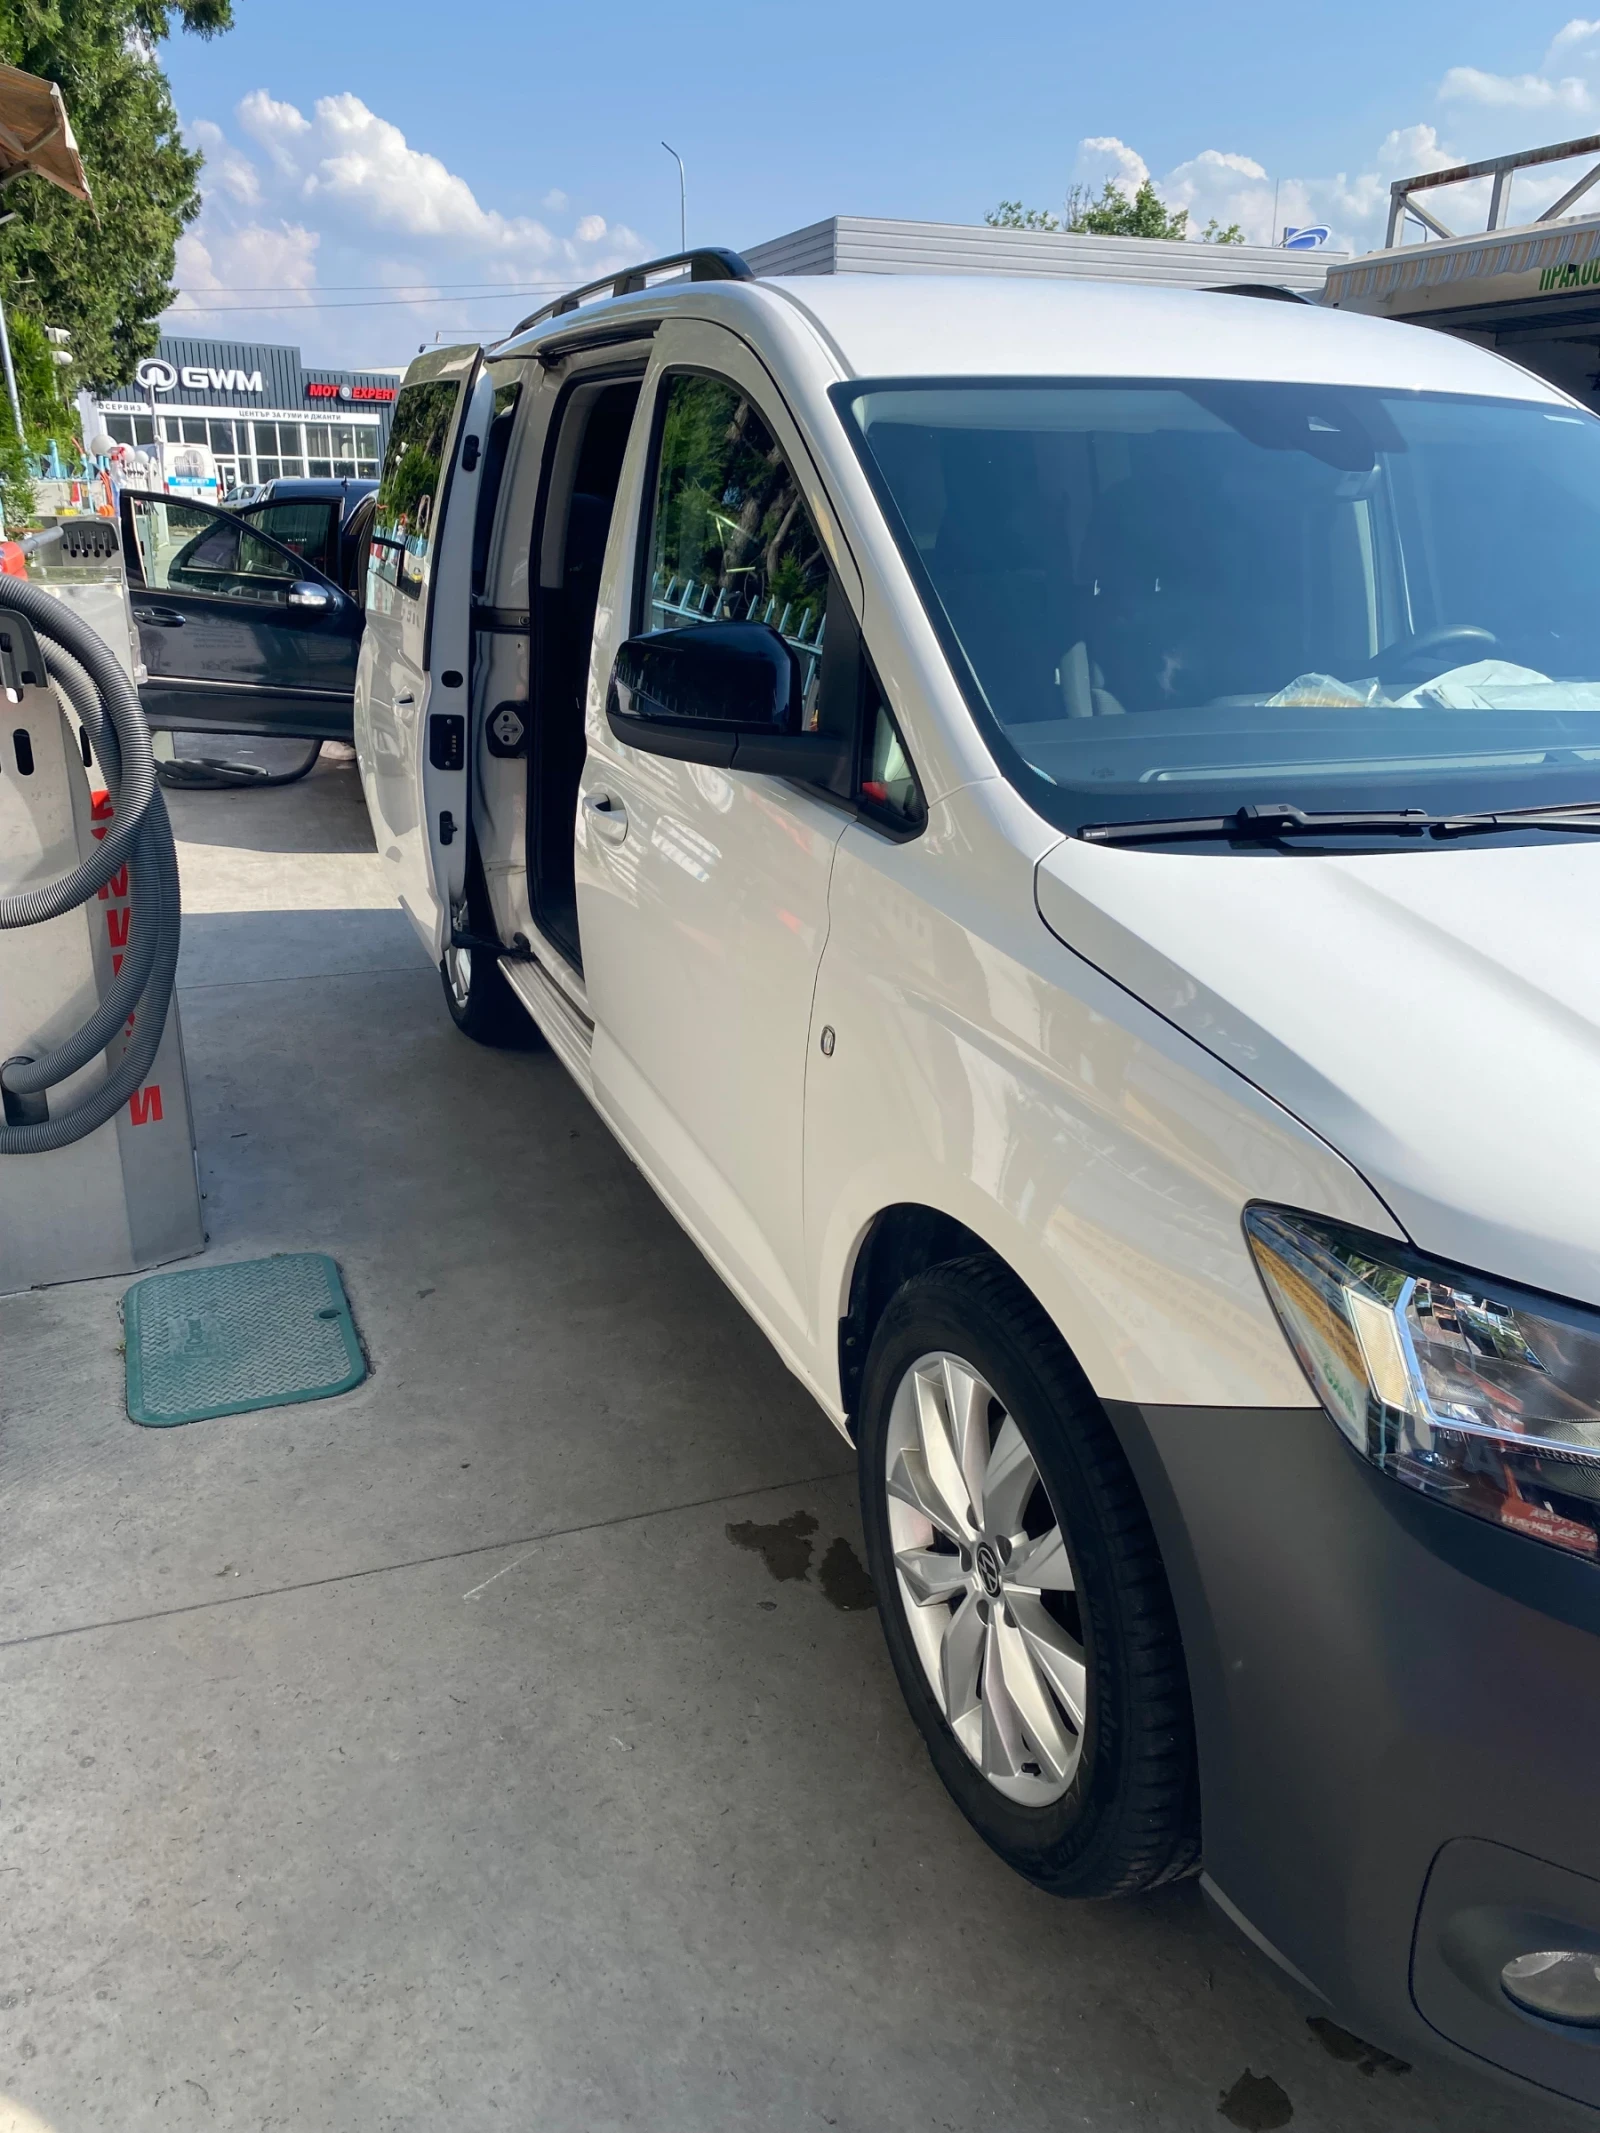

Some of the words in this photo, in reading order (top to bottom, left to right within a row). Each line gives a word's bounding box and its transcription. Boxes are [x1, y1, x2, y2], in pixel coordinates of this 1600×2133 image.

[181, 366, 263, 392] GWM
[352, 387, 398, 401] EXPERT
[239, 410, 271, 418] ЦЕНТЪР
[272, 411, 282, 419] ЗА
[310, 413, 342, 421] ДЖАНТИ
